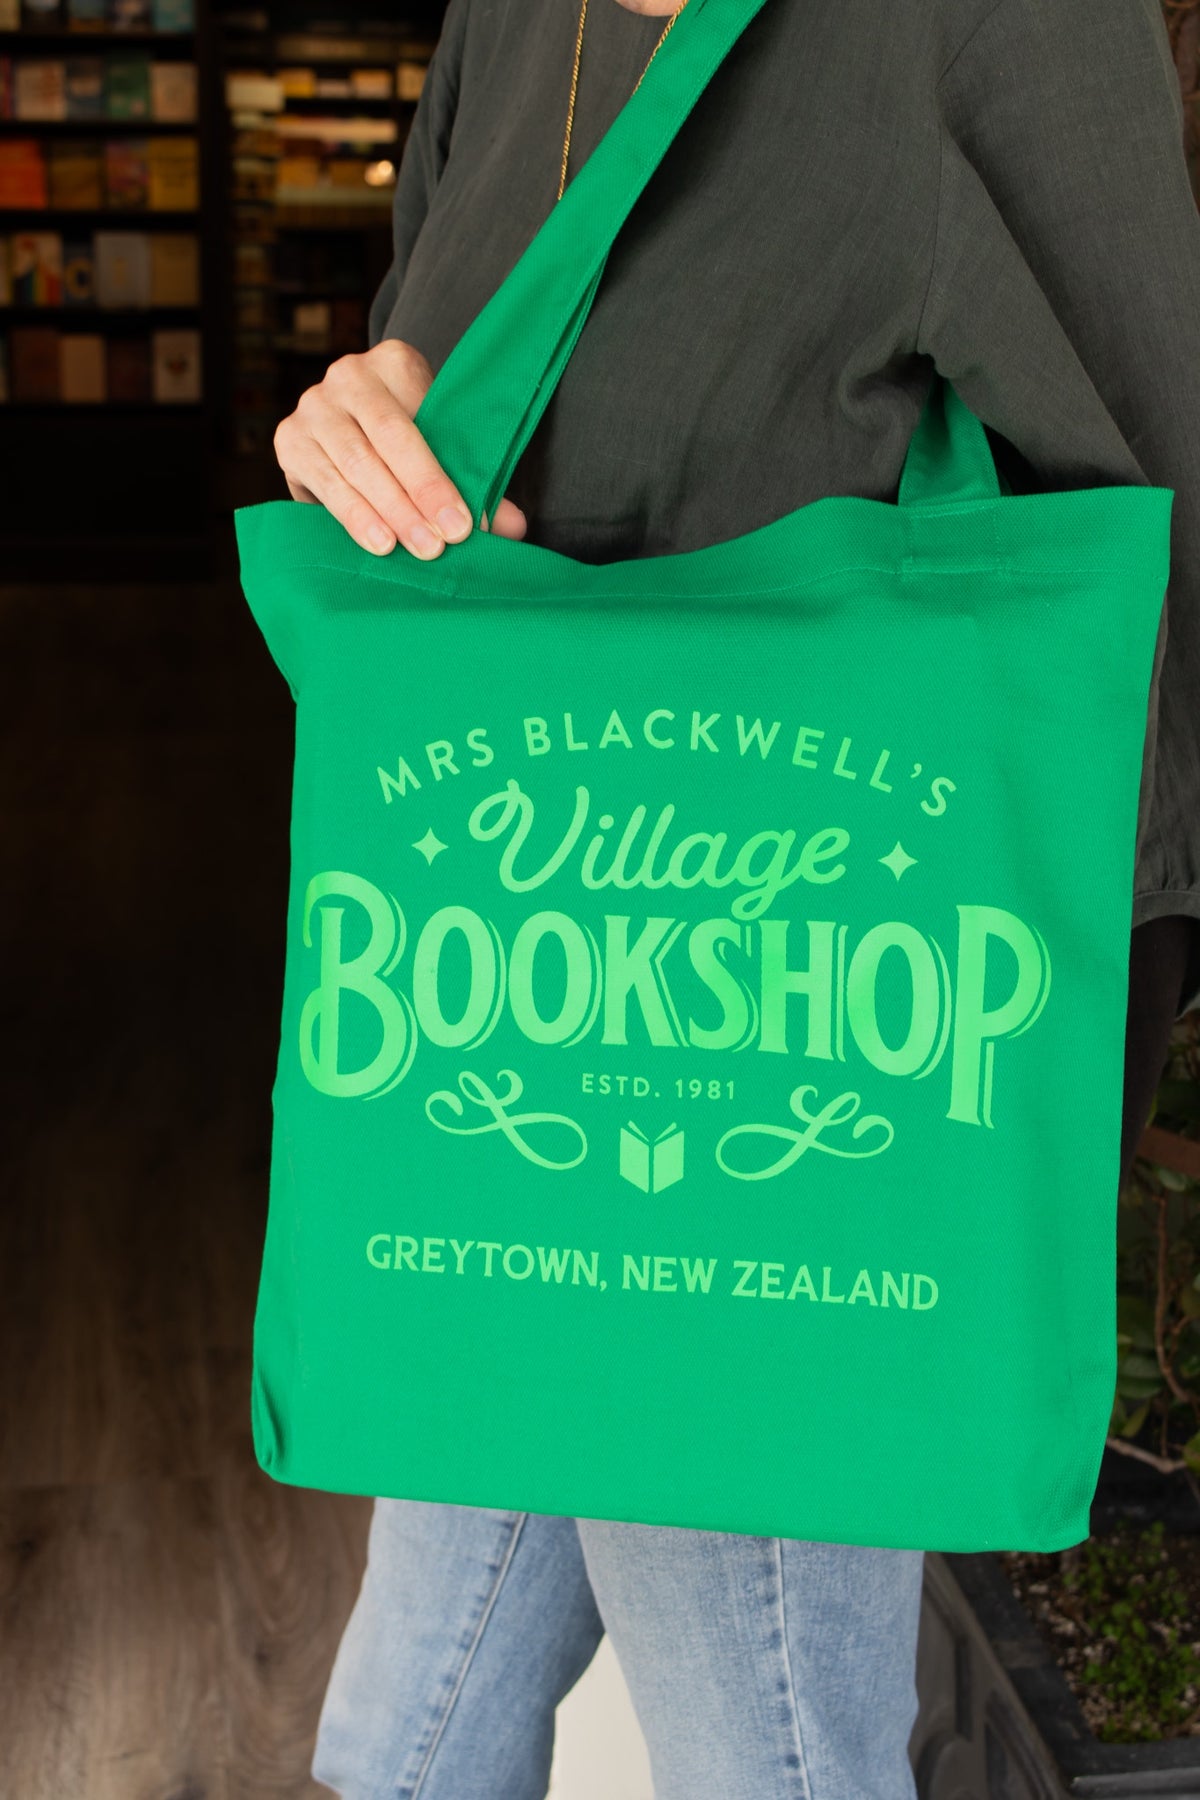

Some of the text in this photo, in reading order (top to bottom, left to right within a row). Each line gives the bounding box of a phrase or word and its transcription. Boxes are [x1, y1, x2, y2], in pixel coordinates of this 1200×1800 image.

[376, 708, 957, 818] MRS BLACKWELL'S
[468, 778, 850, 921] Village
[298, 870, 1052, 1129] BOOKSHOP
[582, 1073, 735, 1100] ESTD. 1981
[365, 1232, 940, 1312] GREYTOWN, NEW ZEALAND
